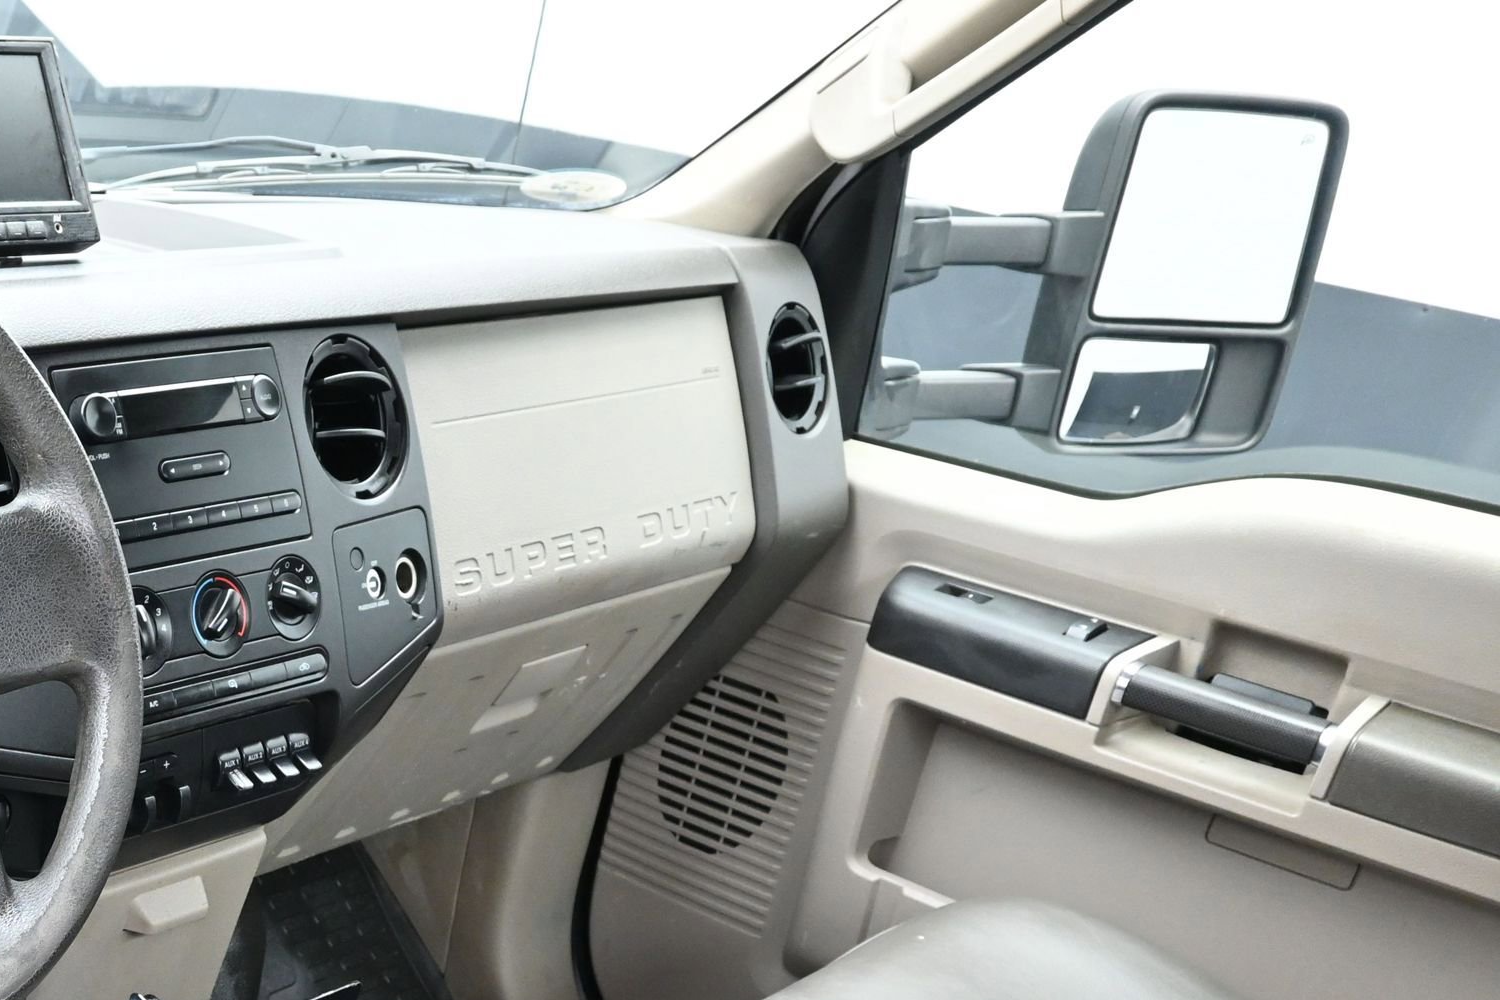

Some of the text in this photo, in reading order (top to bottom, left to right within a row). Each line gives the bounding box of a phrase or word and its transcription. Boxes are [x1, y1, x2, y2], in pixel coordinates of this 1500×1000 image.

[152, 521, 158, 531] 2
[187, 515, 194, 525] 3
[221, 509, 227, 518] 4
[252, 504, 259, 513] 5
[453, 491, 739, 598] SUPER DUTY
[144, 594, 150, 604] 2
[155, 607, 162, 617] 3
[161, 623, 167, 632] 4
[224, 760, 236, 768] AUX
